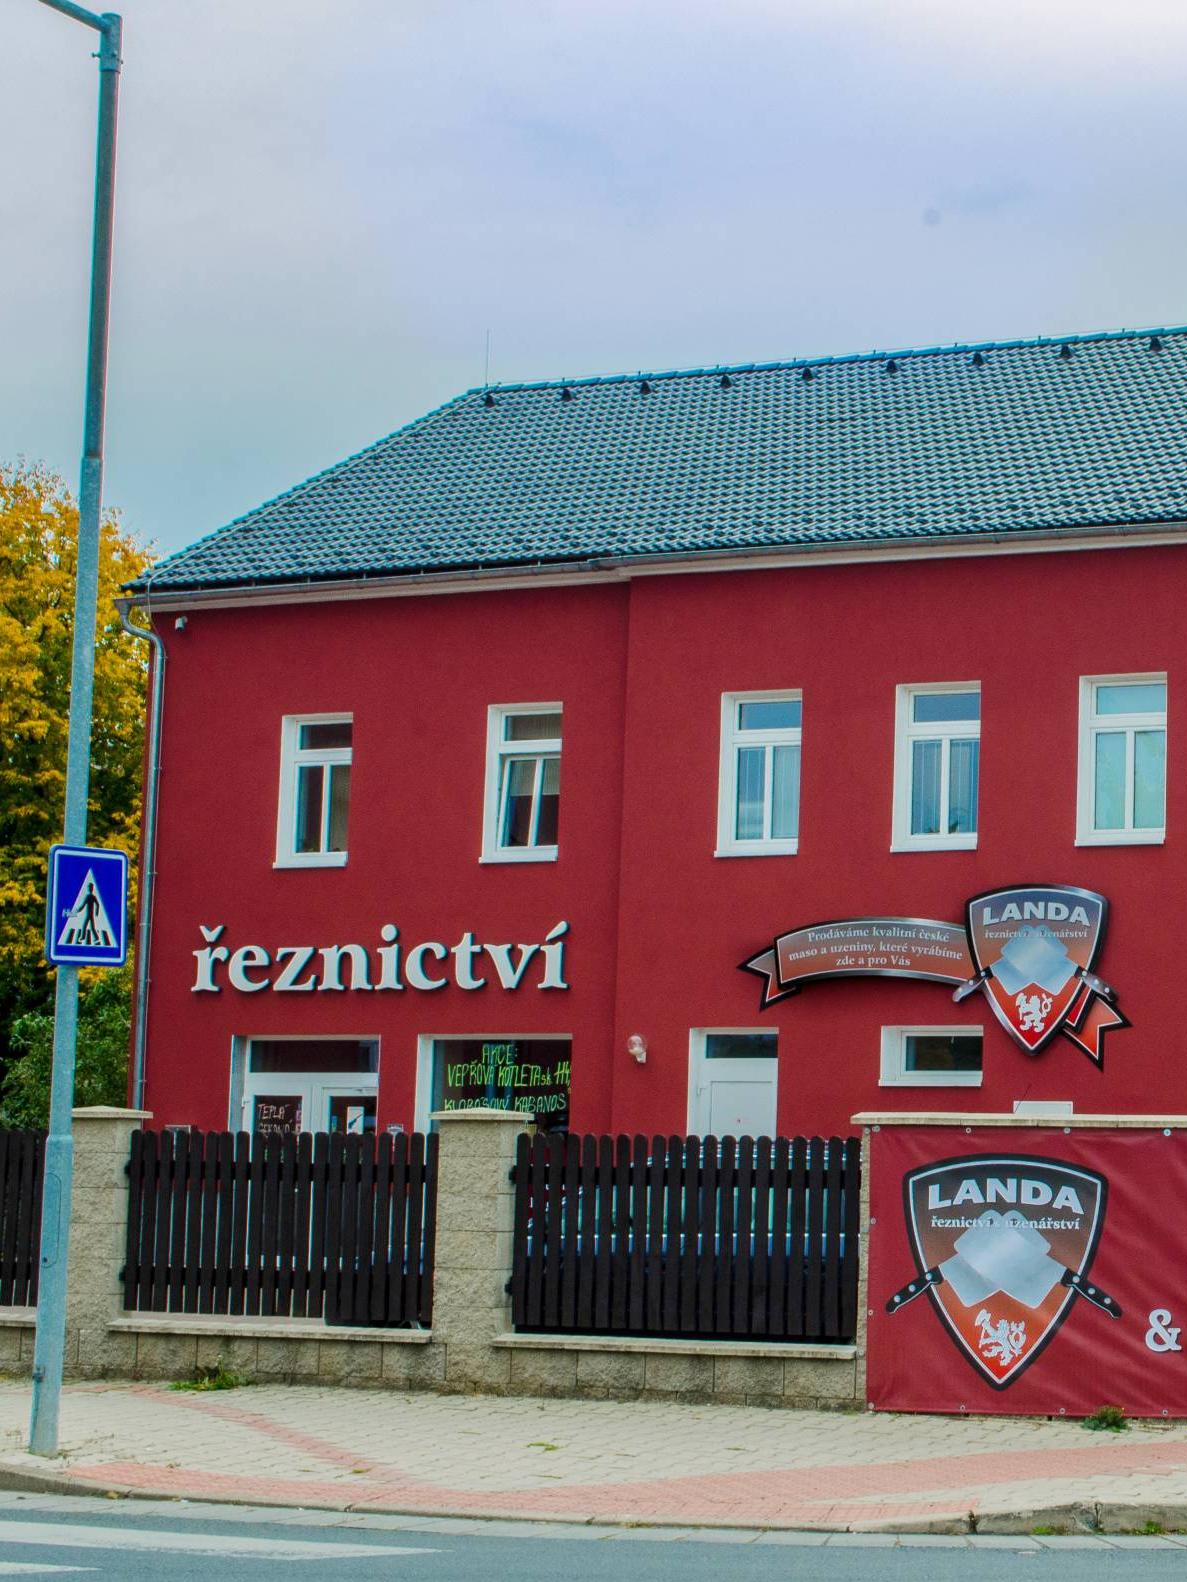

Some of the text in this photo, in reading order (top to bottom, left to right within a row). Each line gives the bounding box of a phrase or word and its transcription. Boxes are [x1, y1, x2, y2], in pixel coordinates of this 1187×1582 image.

[983, 901, 1091, 927] LANDA
[807, 926, 950, 943] Prodáváme kvalitní české
[191, 920, 569, 993] řeznictví
[789, 942, 963, 962] maso a uzeniny, které vyrábíme
[836, 955, 911, 968] zde a pro Vás
[497, 1064, 541, 1088] KOTLETA
[514, 1093, 567, 1113] KABANOS
[928, 1178, 1085, 1215] LANDA
[1145, 1308, 1182, 1353] &
